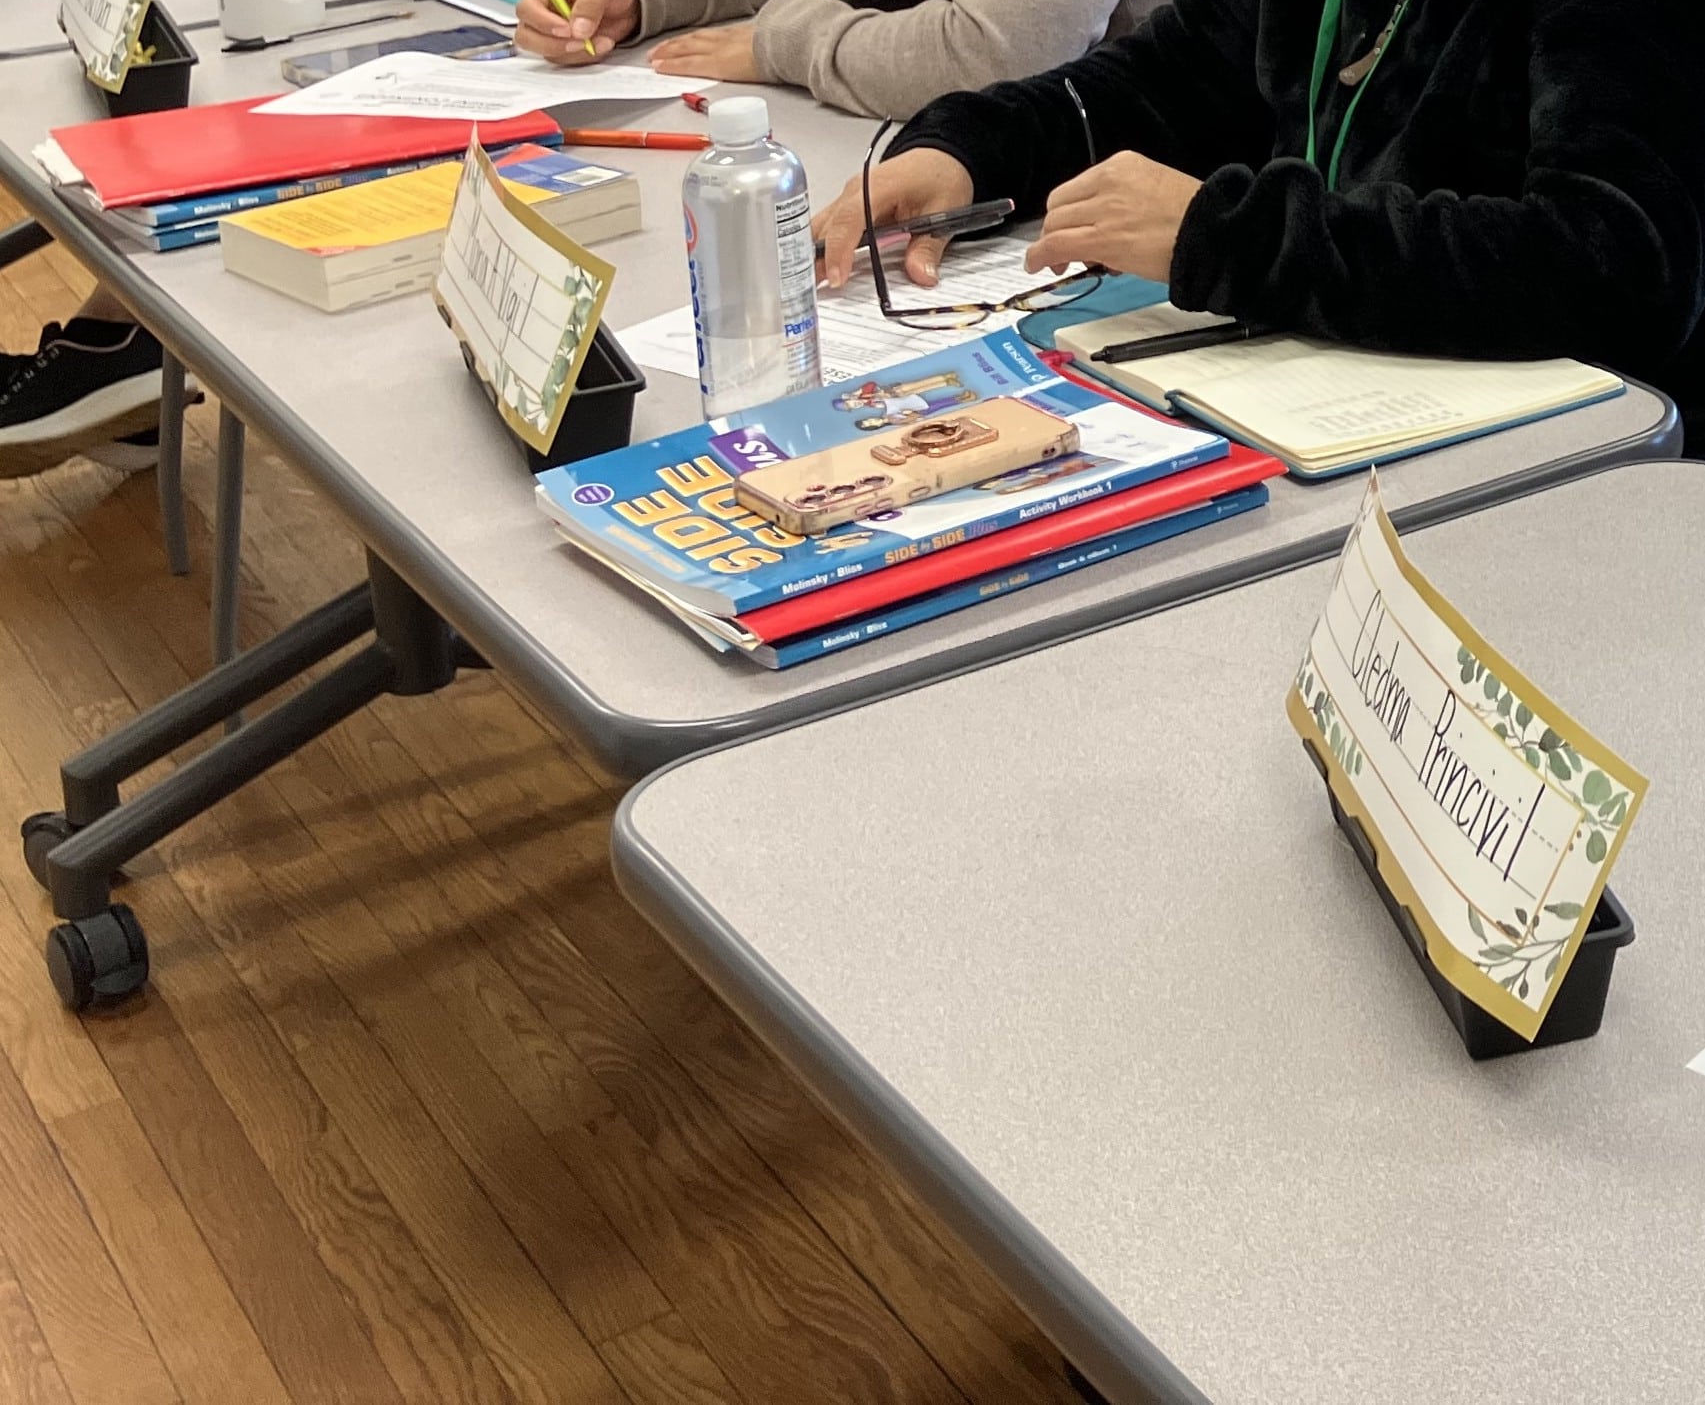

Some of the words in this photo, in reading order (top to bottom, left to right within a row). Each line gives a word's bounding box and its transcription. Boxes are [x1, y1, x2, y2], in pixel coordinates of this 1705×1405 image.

[1001, 341, 1037, 375] Pearson
[611, 488, 785, 575] SIDE
[781, 570, 829, 596] Molinsky
[836, 561, 864, 579] Bliss
[883, 544, 920, 566] SIDE
[930, 527, 967, 551] SIDE
[1018, 498, 1058, 521] Activity
[1058, 484, 1105, 508] Workbook
[1104, 480, 1113, 492] 1
[822, 630, 861, 649] Molinsky
[865, 620, 889, 635] Bliss
[1417, 689, 1547, 882] Princivil
